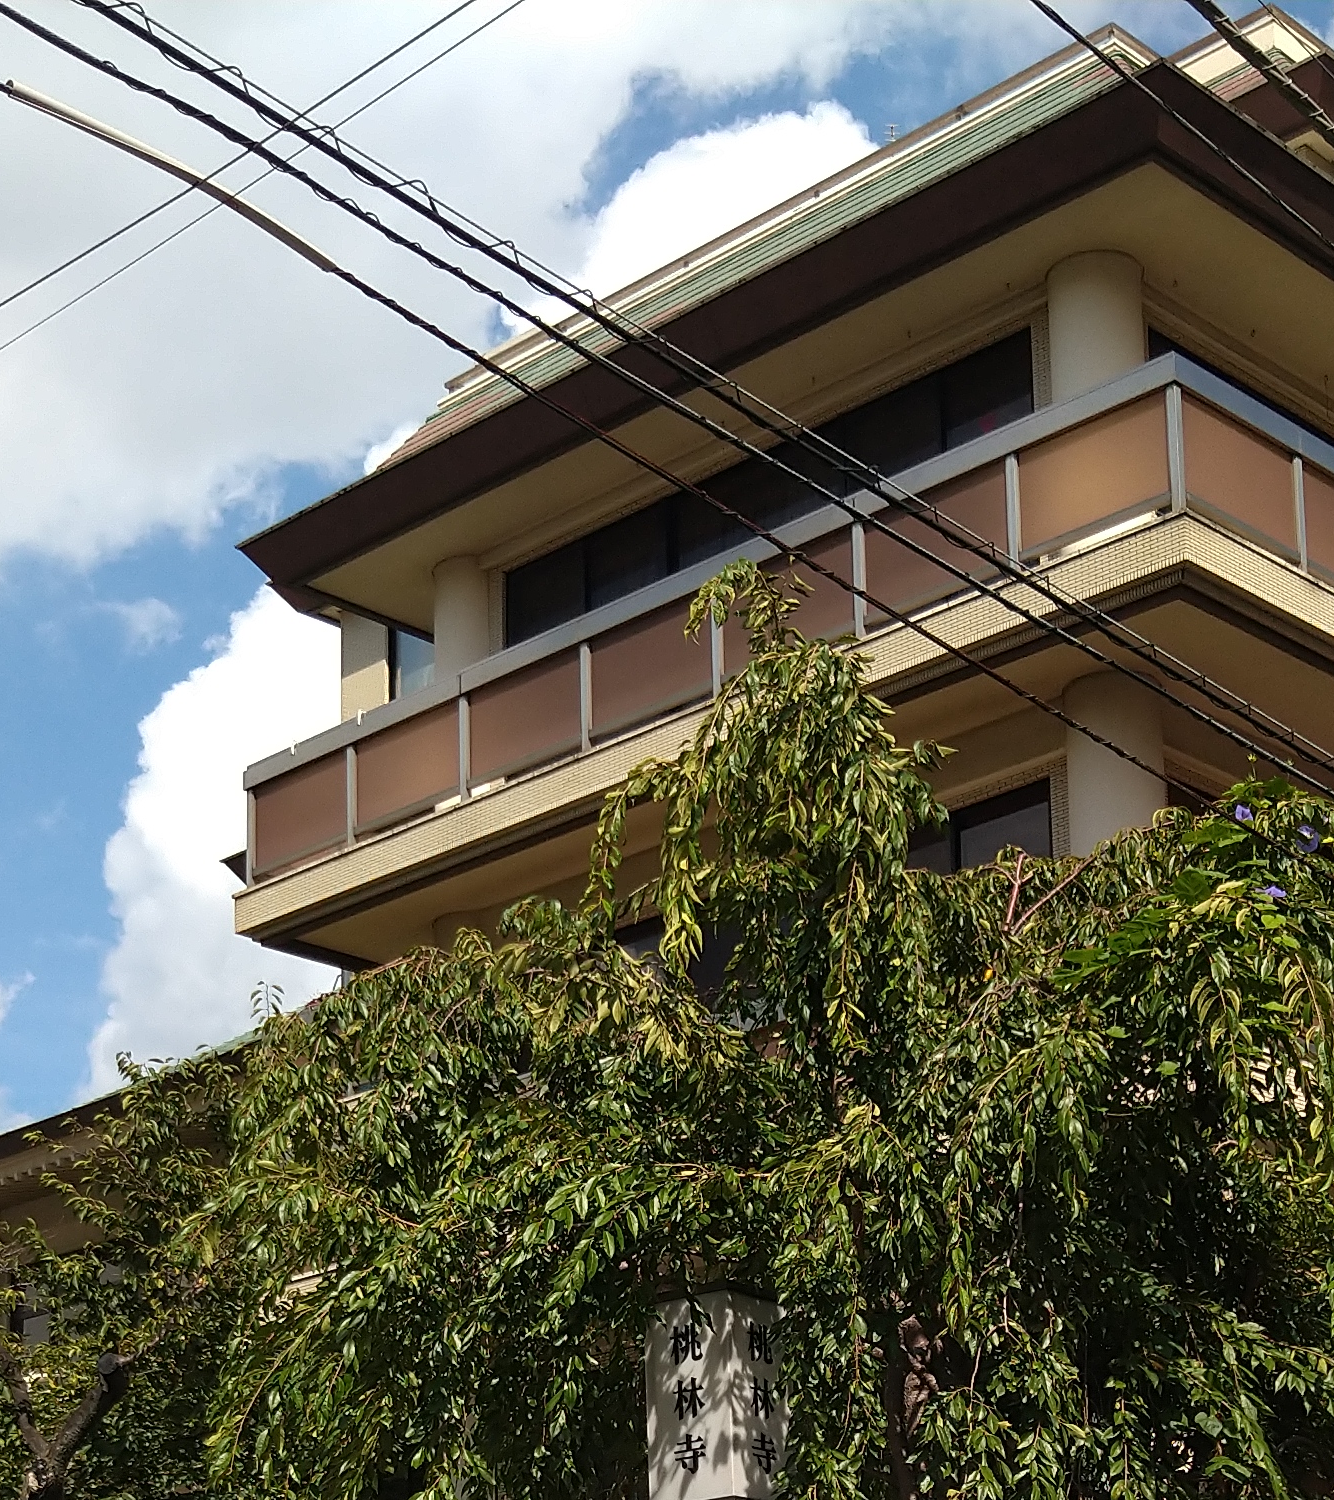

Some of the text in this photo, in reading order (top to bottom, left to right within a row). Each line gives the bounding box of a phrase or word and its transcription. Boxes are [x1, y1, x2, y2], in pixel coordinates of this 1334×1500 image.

[670, 1324, 706, 1474] 桃林寺
[747, 1321, 777, 1475] 桃林寺
